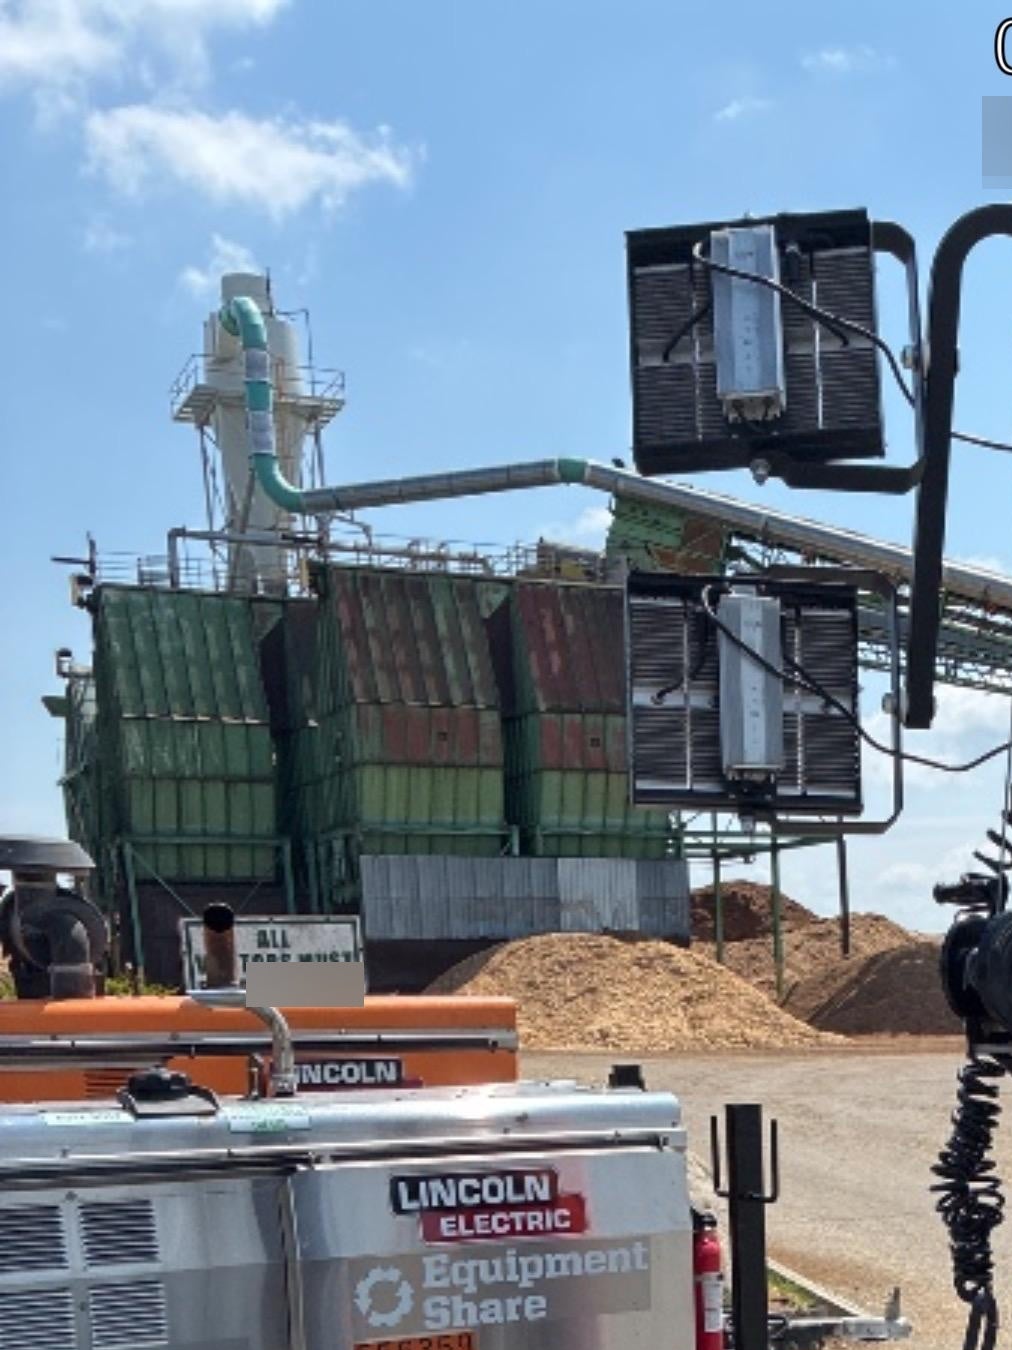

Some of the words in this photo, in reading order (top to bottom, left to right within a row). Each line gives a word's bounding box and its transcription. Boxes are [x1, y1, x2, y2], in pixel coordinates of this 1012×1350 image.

[257, 929, 291, 949] ALL
[294, 1061, 397, 1084] INCOLN
[399, 1174, 550, 1210] LINCOLN
[440, 1208, 571, 1238] ELECTRIC
[422, 1242, 649, 1295] Equipment
[422, 1294, 548, 1330] Share
